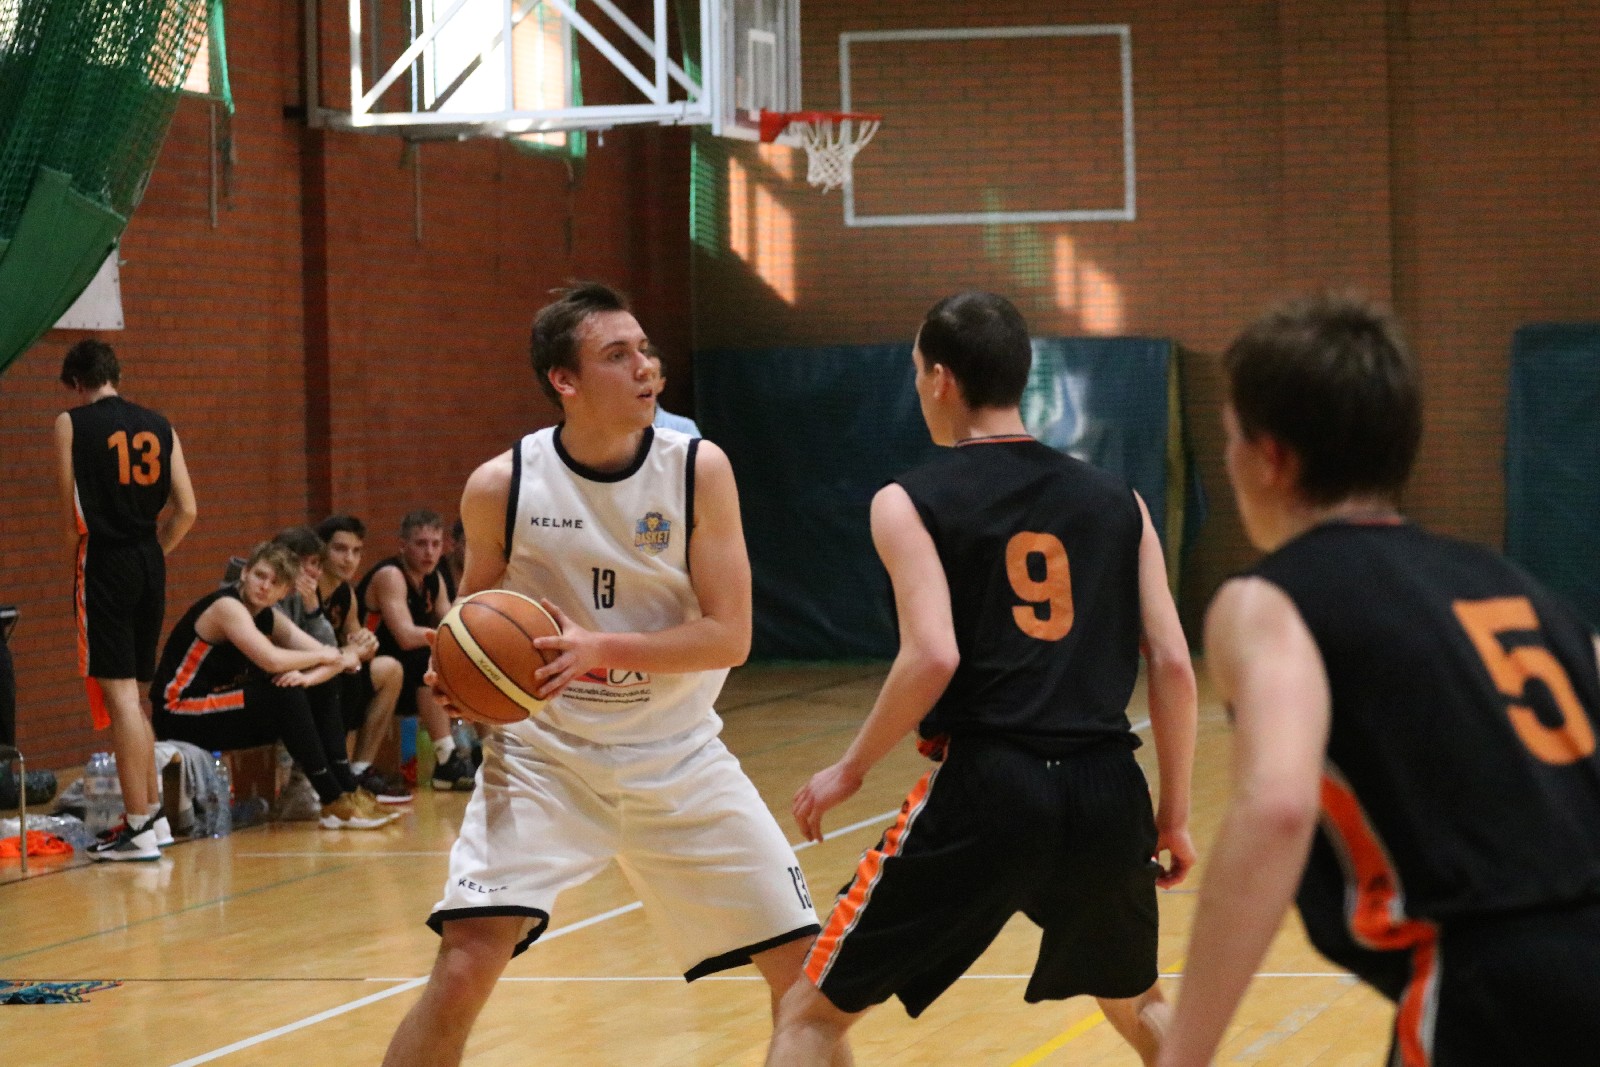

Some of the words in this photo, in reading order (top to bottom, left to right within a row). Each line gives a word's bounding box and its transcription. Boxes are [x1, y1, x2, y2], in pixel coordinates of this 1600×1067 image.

[107, 429, 161, 486] 13
[530, 517, 583, 529] KELME
[592, 567, 616, 610] 13
[1005, 531, 1075, 641] 9
[1452, 596, 1595, 766] 5
